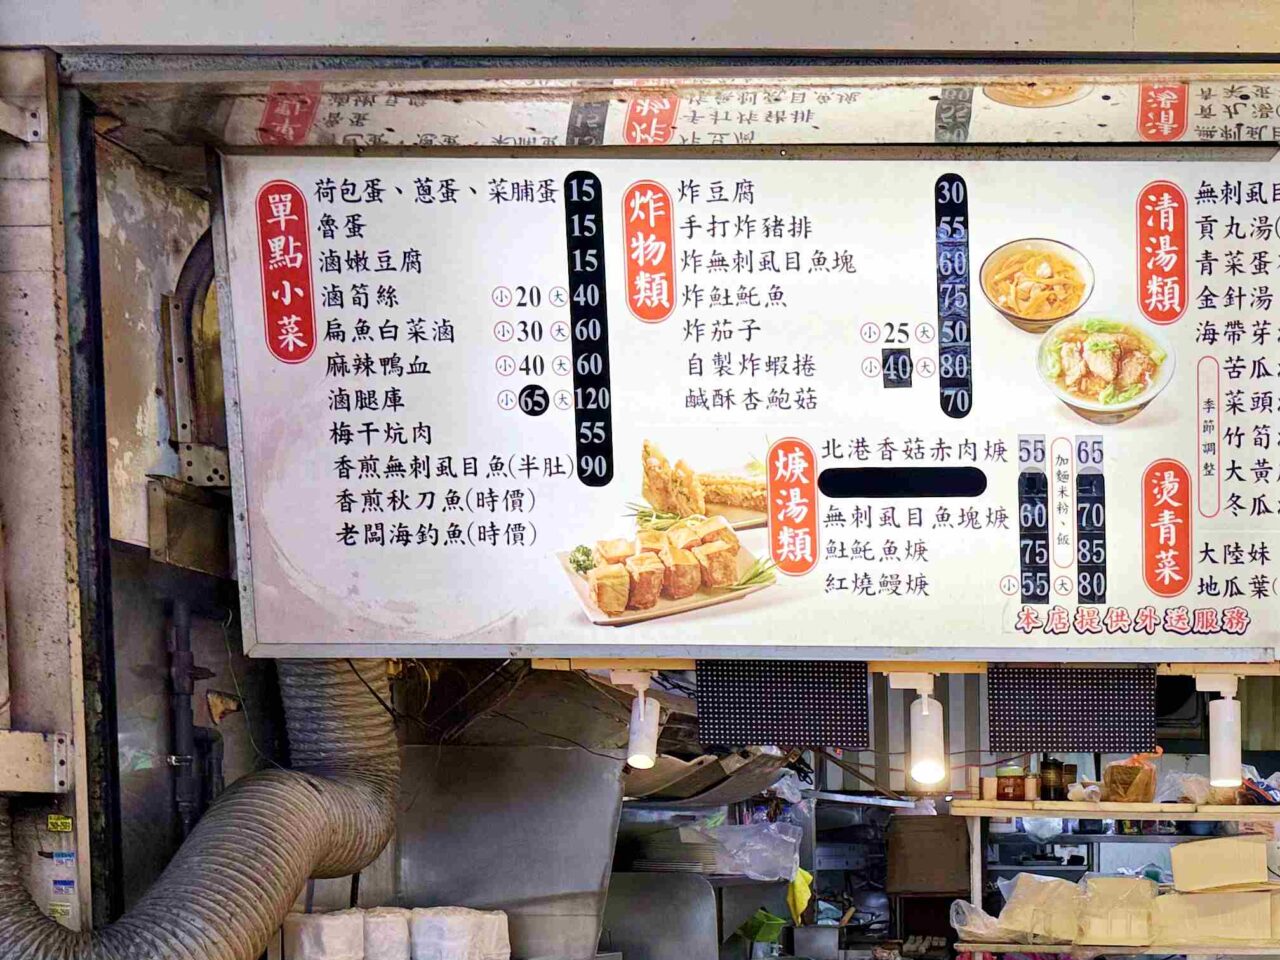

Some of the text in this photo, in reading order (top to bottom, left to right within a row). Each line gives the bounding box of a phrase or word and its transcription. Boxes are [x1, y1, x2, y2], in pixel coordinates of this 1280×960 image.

[569, 178, 595, 202] 15
[677, 180, 964, 204] 炸豆腐 30
[317, 213, 597, 239] 魯蛋 15
[679, 215, 812, 239] 手打炸豬排
[319, 247, 598, 274] 滷嫩豆腐 15
[630, 190, 670, 309] 炸物類
[680, 249, 857, 275] 炸無刺虱目魚塊
[1145, 193, 1181, 313] 清湯類
[267, 194, 308, 352] 單點小菜
[321, 284, 599, 309] 滷筍絲 20 40
[1196, 286, 1273, 310] 金針湯
[323, 318, 601, 343] 扁魚白菜滷 30 60
[683, 319, 910, 344] 炸茄子 25
[326, 352, 603, 378] 麻辣鴨血 40 60
[687, 353, 817, 378] 自製炸蝦捲
[328, 386, 610, 412] 滷腿庫 65 120
[685, 387, 969, 412] 鹹酥杏鮑菇 70
[328, 421, 606, 445] 梅干炕肉 55
[1202, 398, 1216, 477] 季節調整
[1018, 438, 1045, 464] 55
[1077, 439, 1104, 464] 65
[581, 455, 607, 478] 90
[1021, 503, 1047, 527] 60
[1078, 503, 1104, 528] 70
[1151, 471, 1184, 585] 燙青菜
[1021, 540, 1105, 565] 75 85
[1199, 542, 1271, 566] 大陸妹
[1021, 572, 1049, 596] 55
[1078, 572, 1105, 596] 80
[1015, 606, 1250, 634] 本店提供外送服務
